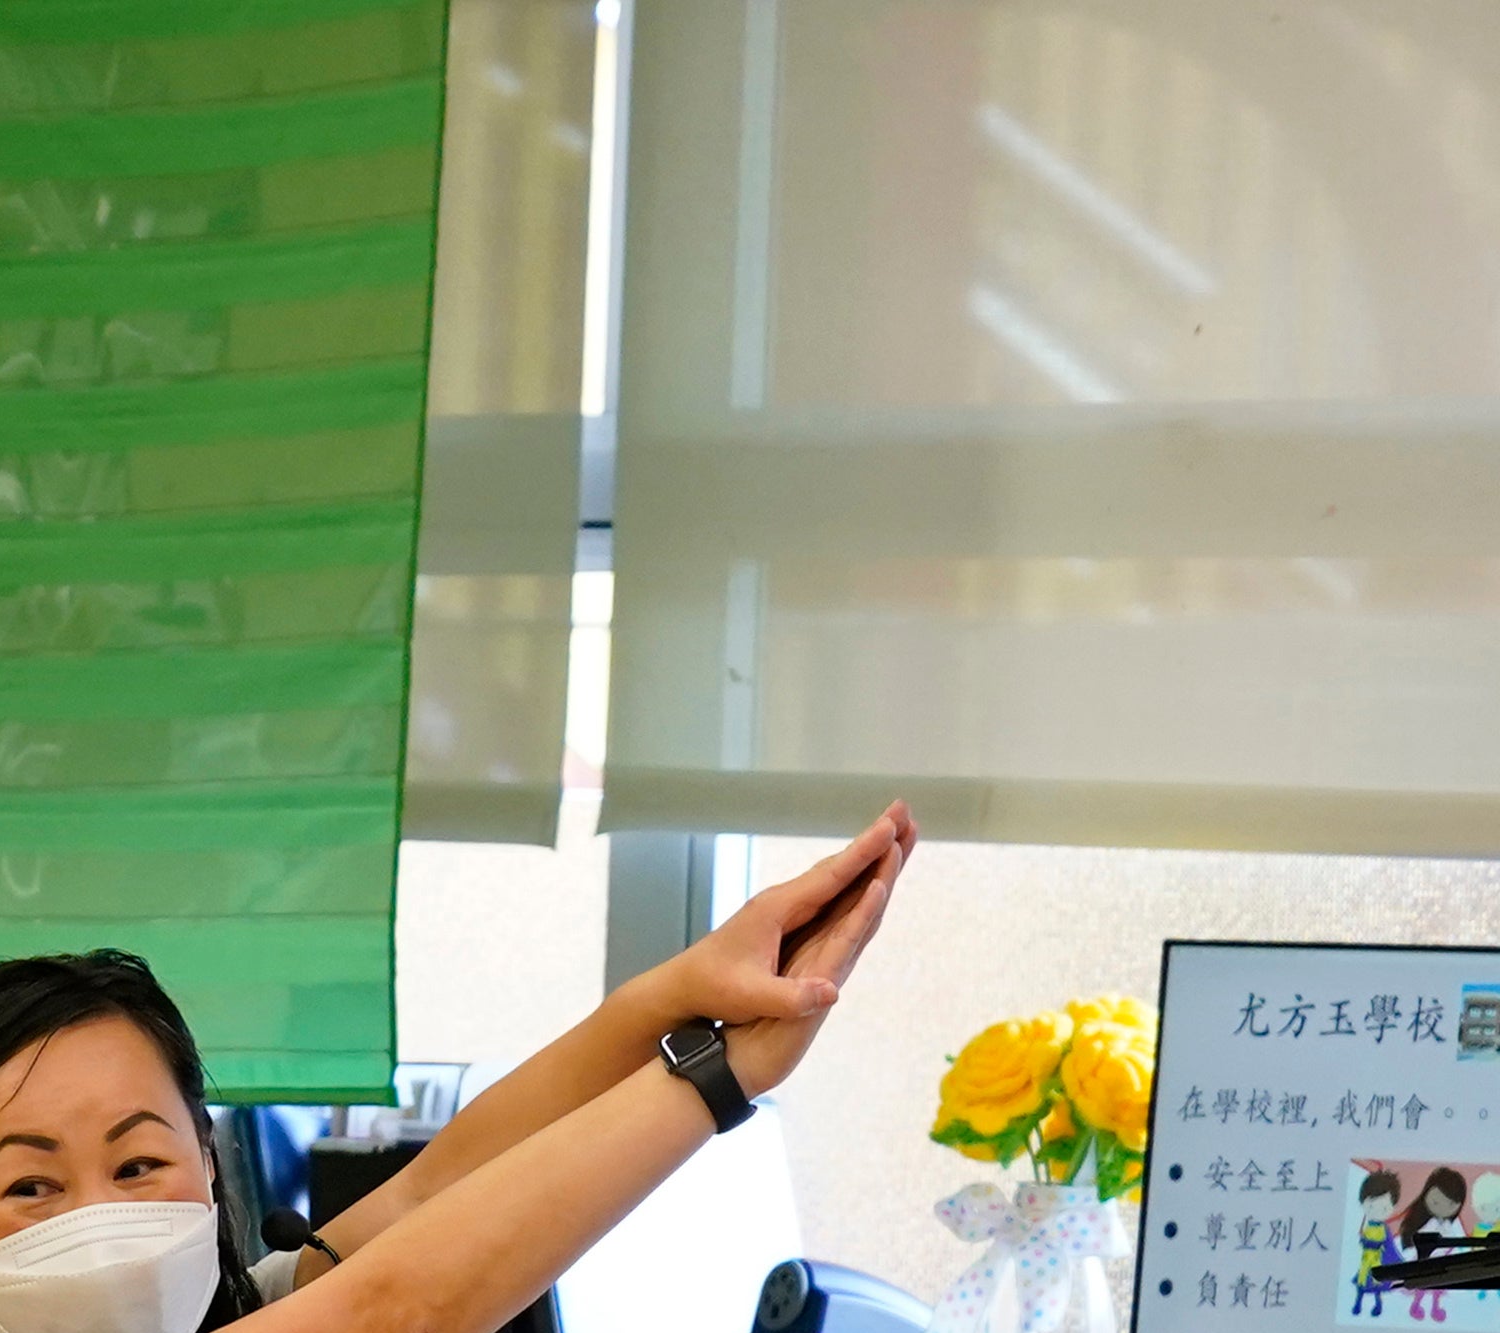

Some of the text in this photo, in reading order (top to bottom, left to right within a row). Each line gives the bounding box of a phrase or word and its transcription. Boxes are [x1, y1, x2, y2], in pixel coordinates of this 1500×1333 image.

[1234, 993, 1446, 1044] 尤方玉學校
[1204, 1156, 1333, 1192] 安全至上
[1199, 1213, 1328, 1252] 尊重別人
[1198, 1270, 1289, 1308] 負責任
